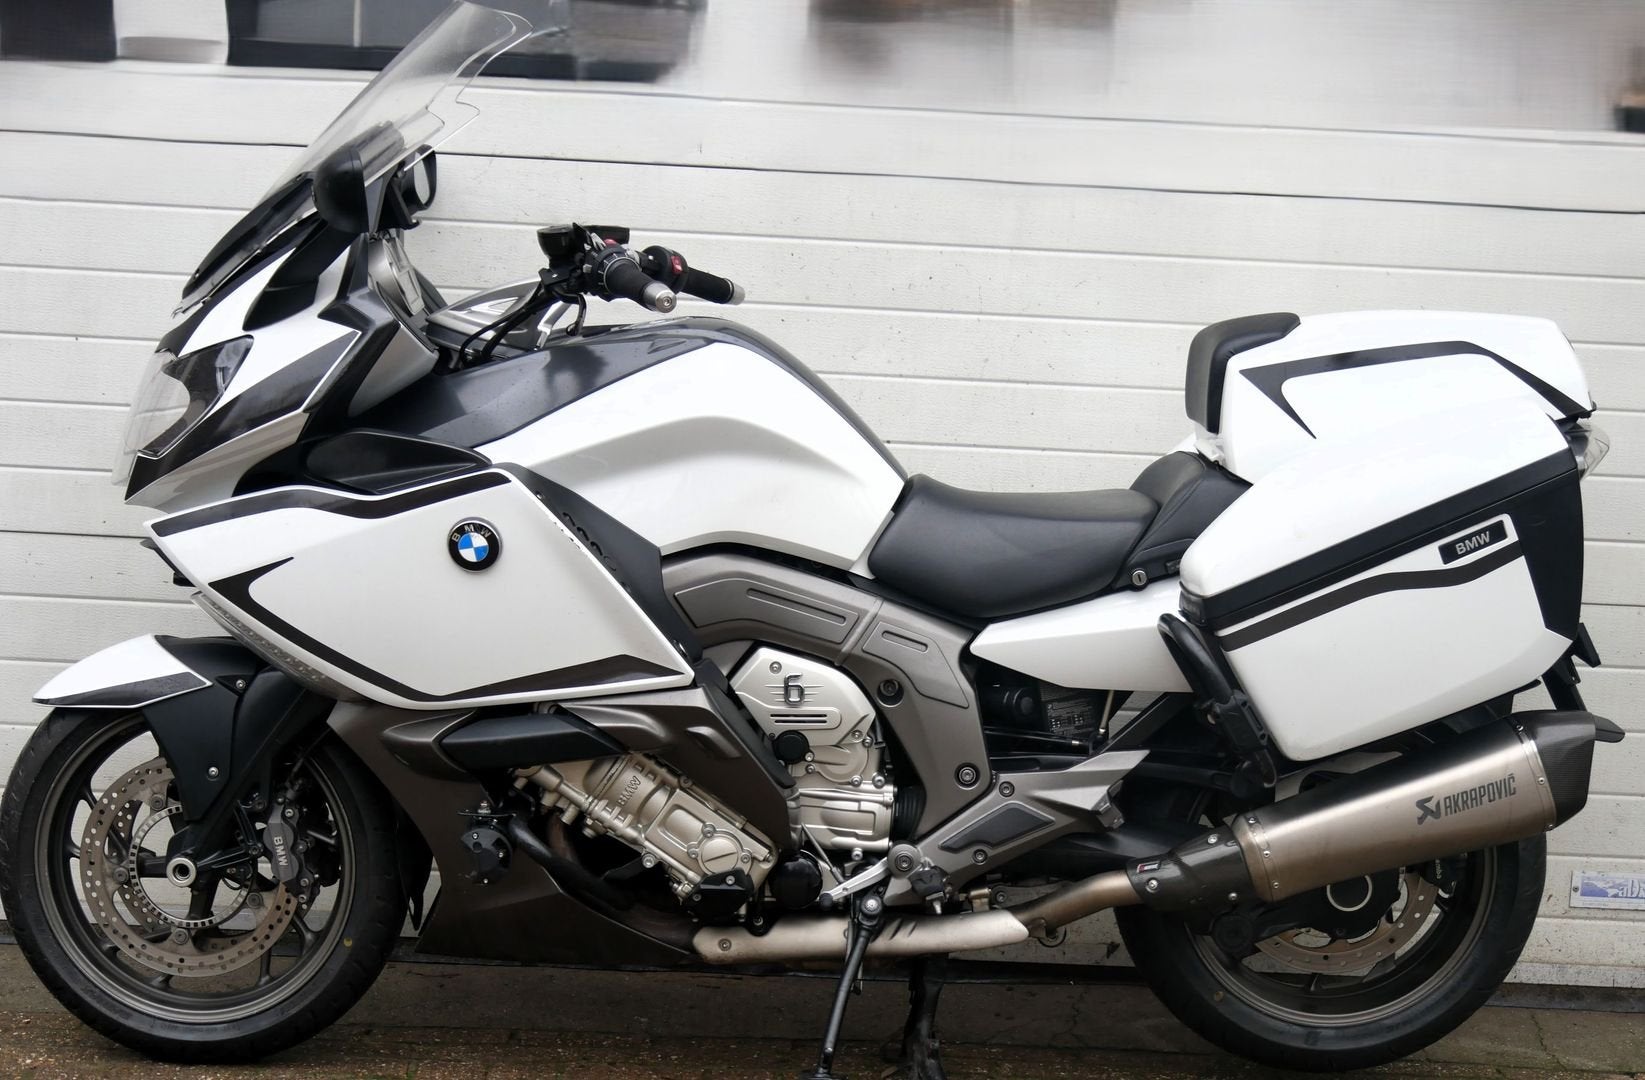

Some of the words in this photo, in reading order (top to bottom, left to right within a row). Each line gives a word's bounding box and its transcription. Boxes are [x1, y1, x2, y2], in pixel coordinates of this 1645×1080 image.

[451, 524, 492, 542] BMW
[1455, 531, 1490, 555] BMW
[784, 673, 806, 707] 6
[616, 775, 641, 806] BMW
[274, 836, 289, 866] BMW
